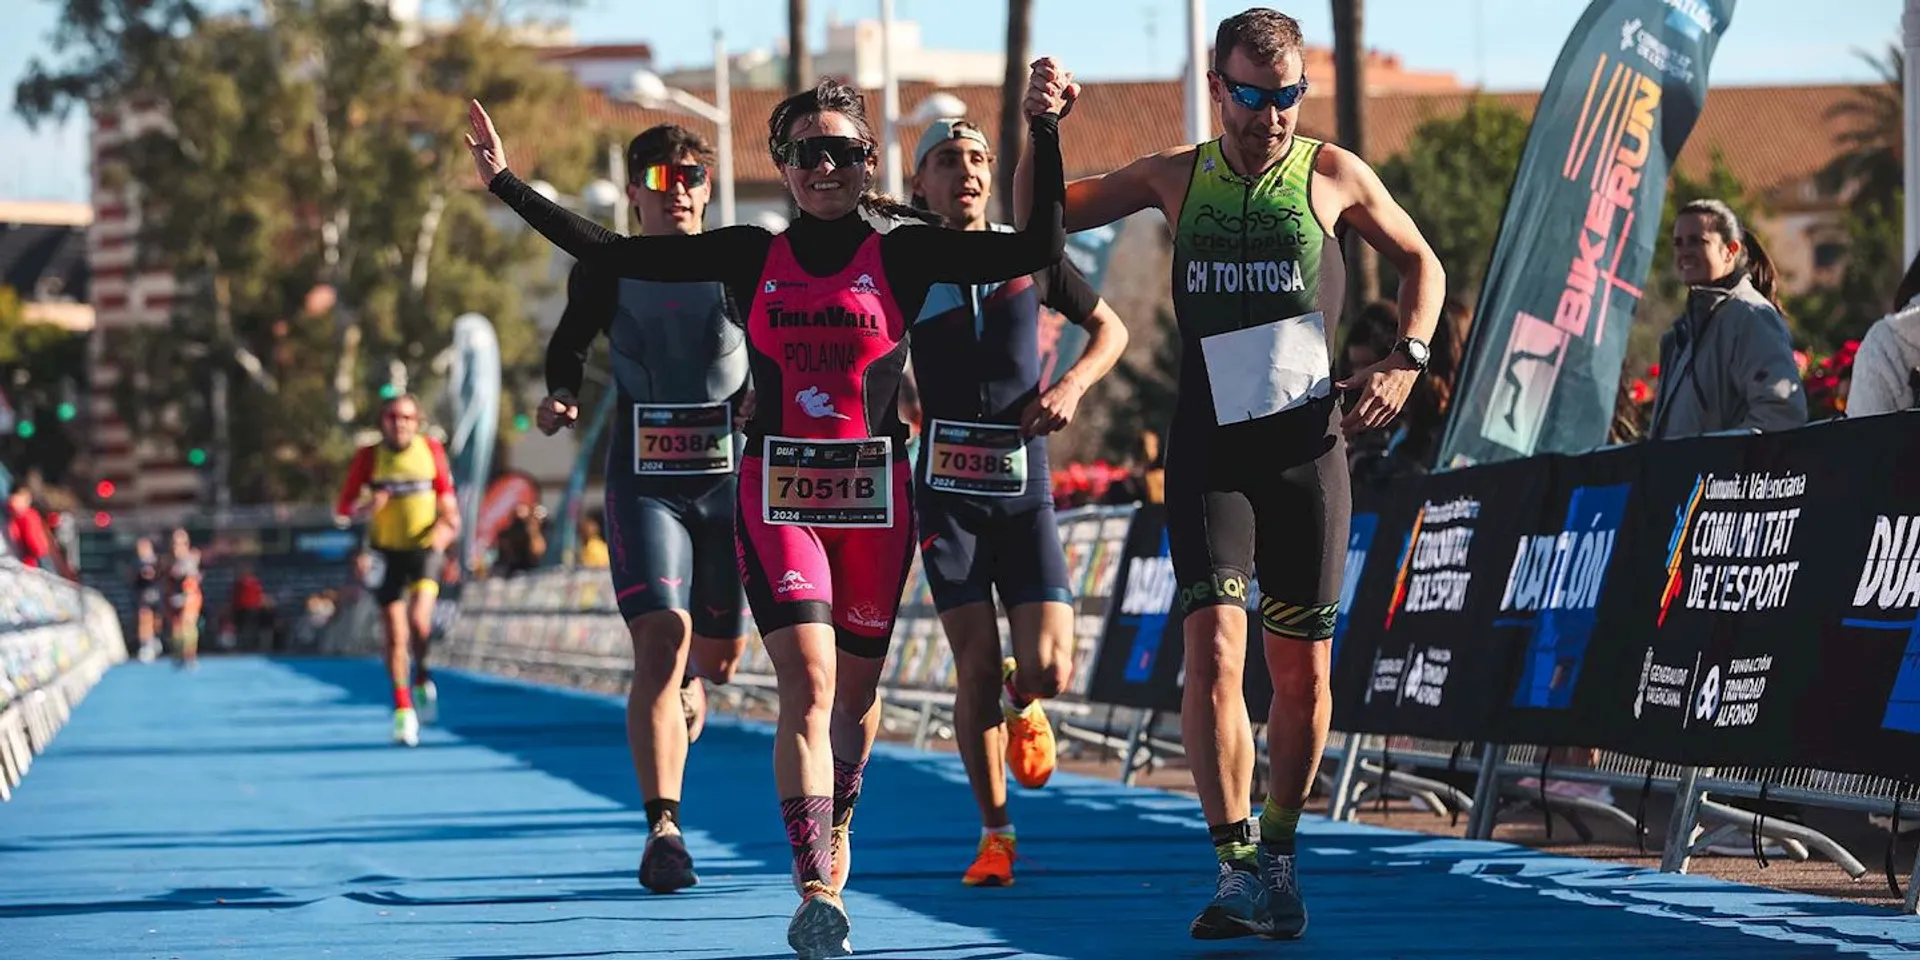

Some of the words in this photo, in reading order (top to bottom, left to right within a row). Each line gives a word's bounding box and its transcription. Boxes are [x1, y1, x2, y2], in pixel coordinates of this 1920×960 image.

[1186, 261, 1207, 293] CH
[1213, 259, 1306, 293] TORTOSA
[784, 342, 857, 373] POLAINA
[644, 434, 719, 453] 7038A
[641, 462, 664, 471] 2024
[939, 450, 1013, 474] 7038B
[777, 477, 876, 499] 7051B
[932, 478, 956, 487] 2024
[1748, 470, 1806, 500] Valenciana
[772, 510, 800, 520] 2024
[1691, 508, 1801, 558] COMUNITAT
[1500, 512, 1616, 612] DUATLÓN
[1685, 562, 1714, 610] DE
[1708, 561, 1799, 612] L'ESPORT
[1722, 676, 1766, 701] TRINIDAD
[1714, 702, 1758, 727] ALFONSO
